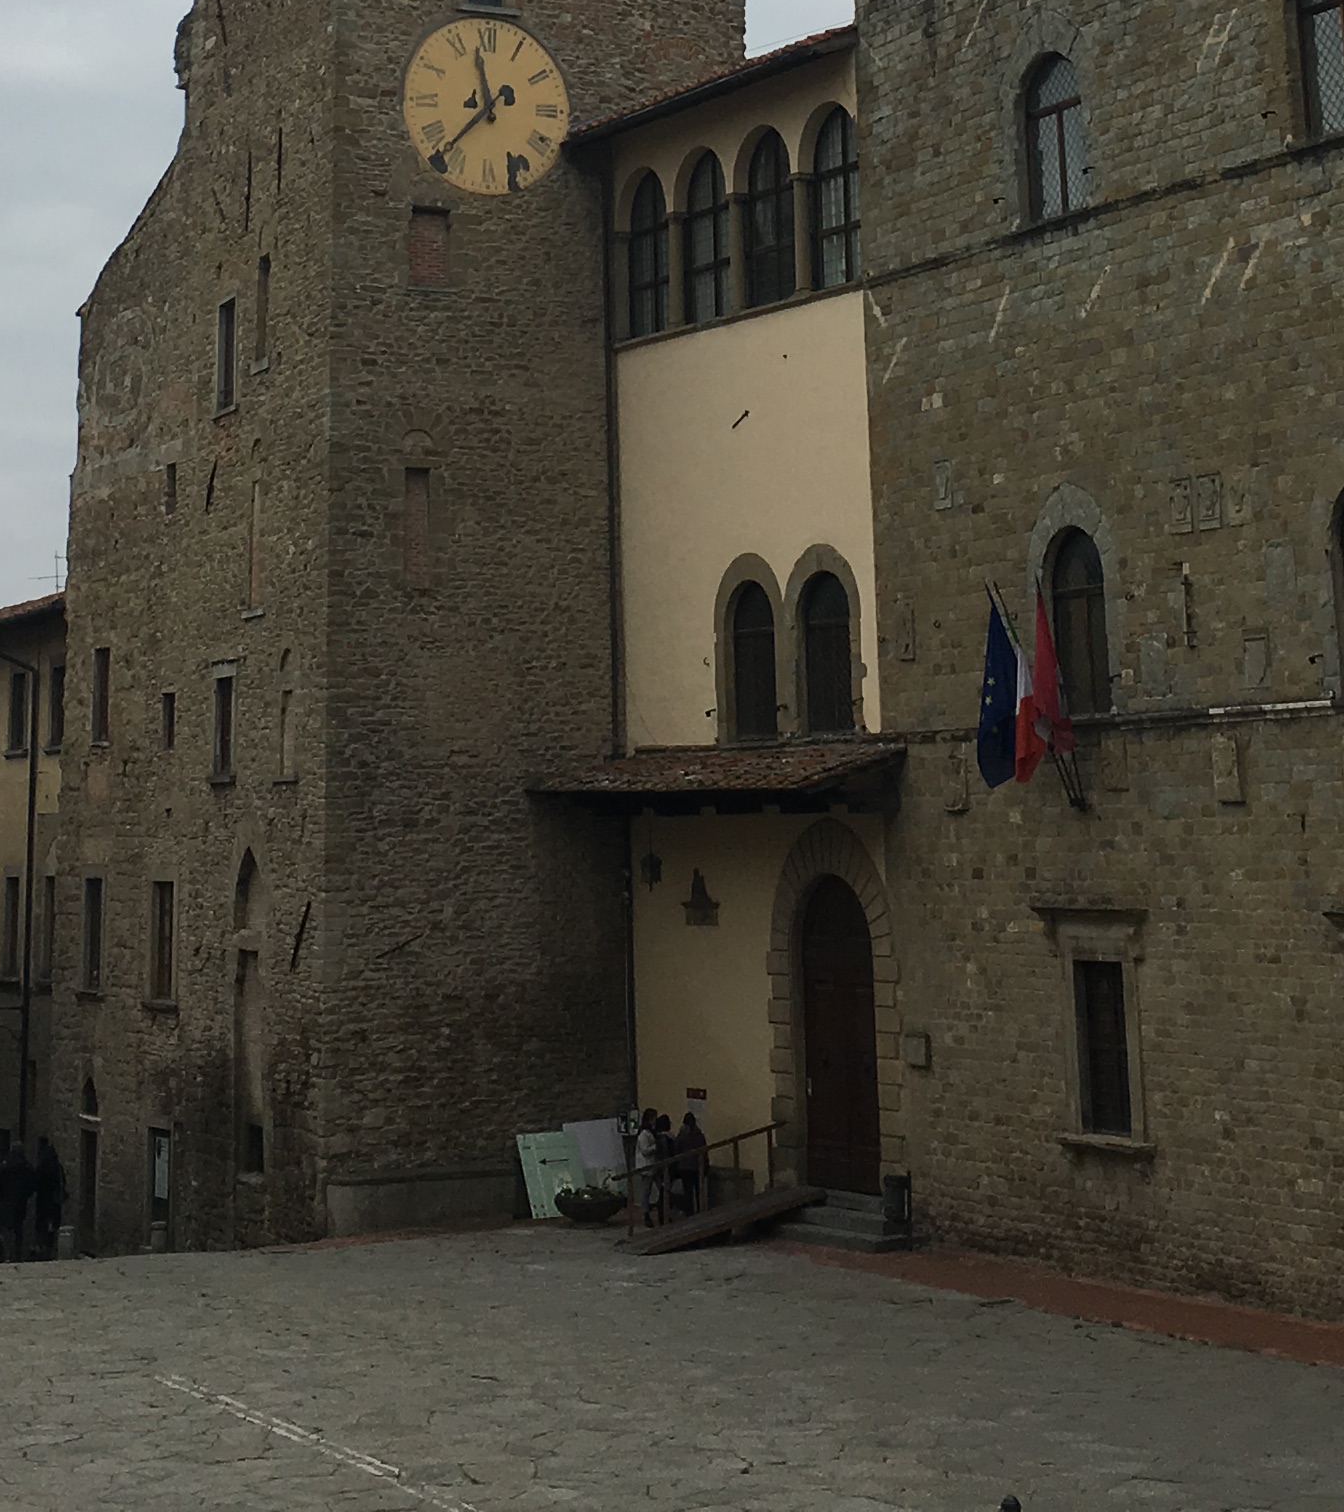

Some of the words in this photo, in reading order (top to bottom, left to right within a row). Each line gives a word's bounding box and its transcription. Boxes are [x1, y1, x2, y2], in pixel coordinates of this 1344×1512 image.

[446, 33, 467, 60] XI
[477, 27, 497, 53] XII
[510, 39, 524, 62] I
[422, 62, 446, 80] X
[528, 68, 550, 86] II
[535, 104, 558, 119] III
